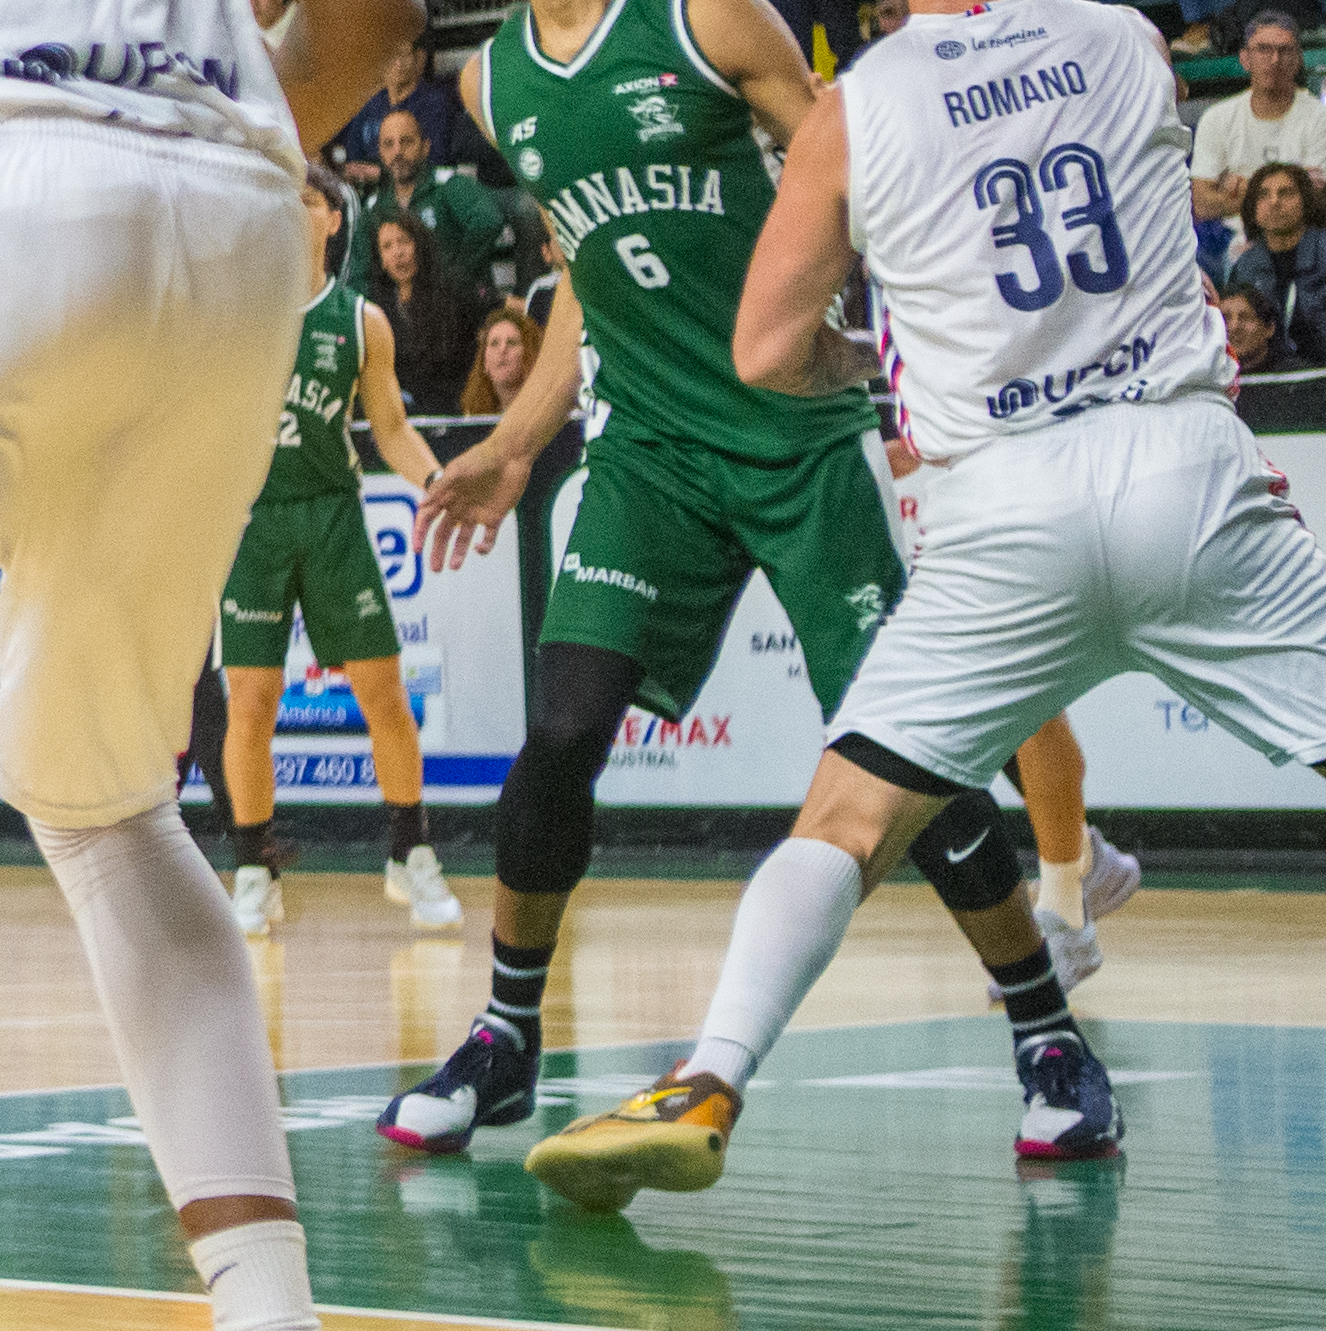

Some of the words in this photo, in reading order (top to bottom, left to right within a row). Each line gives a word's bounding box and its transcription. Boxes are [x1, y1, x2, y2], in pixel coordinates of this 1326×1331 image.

[612, 77, 660, 95] AXION
[943, 61, 1088, 128] ROMANO
[974, 143, 1130, 312] 33
[614, 233, 671, 290] 6
